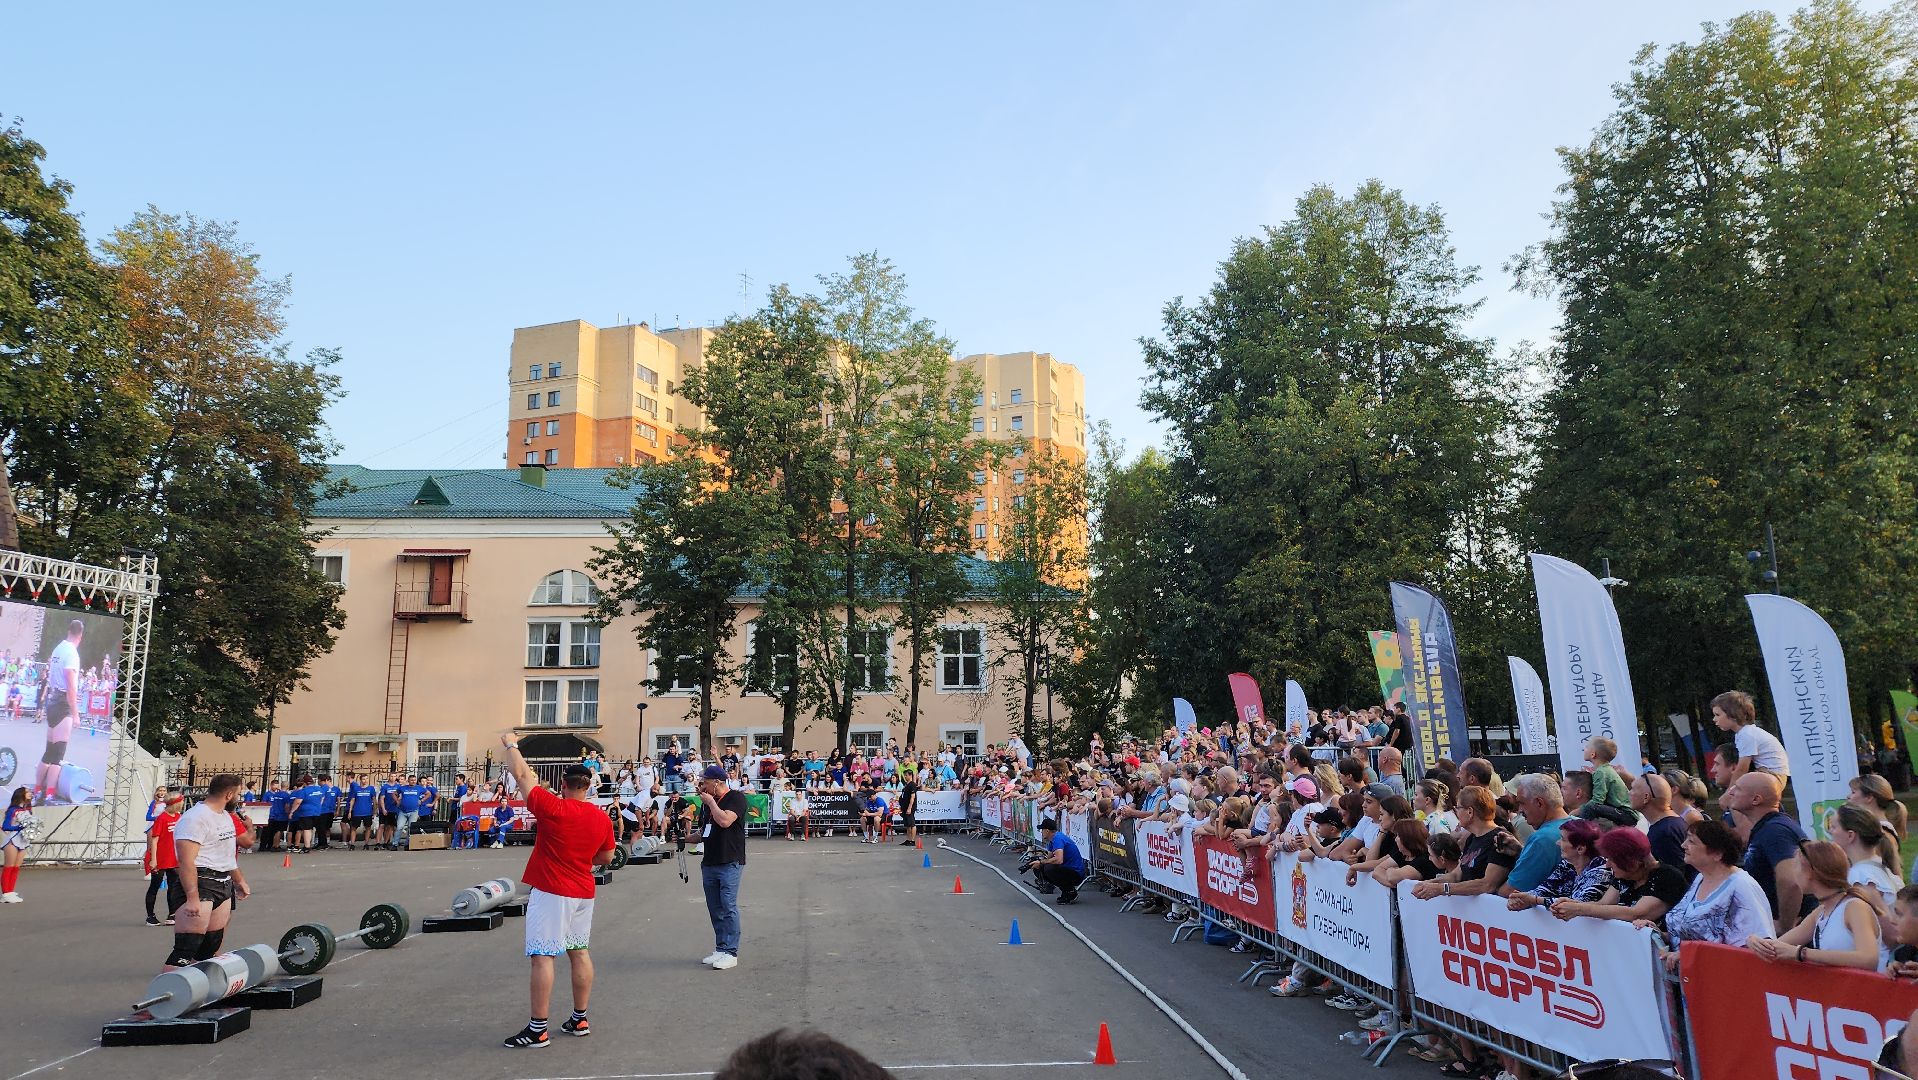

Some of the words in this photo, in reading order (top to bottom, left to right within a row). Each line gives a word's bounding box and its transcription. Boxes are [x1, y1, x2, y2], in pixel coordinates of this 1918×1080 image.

[807, 794, 849, 802] ГОРОДСКОЙ
[1314, 886, 1354, 916] КОМАНДА
[1313, 914, 1371, 954] ГУБЕРНАТОРА
[1437, 914, 1593, 987] МОСОБЛ
[1441, 949, 1557, 1015] СПОРТ
